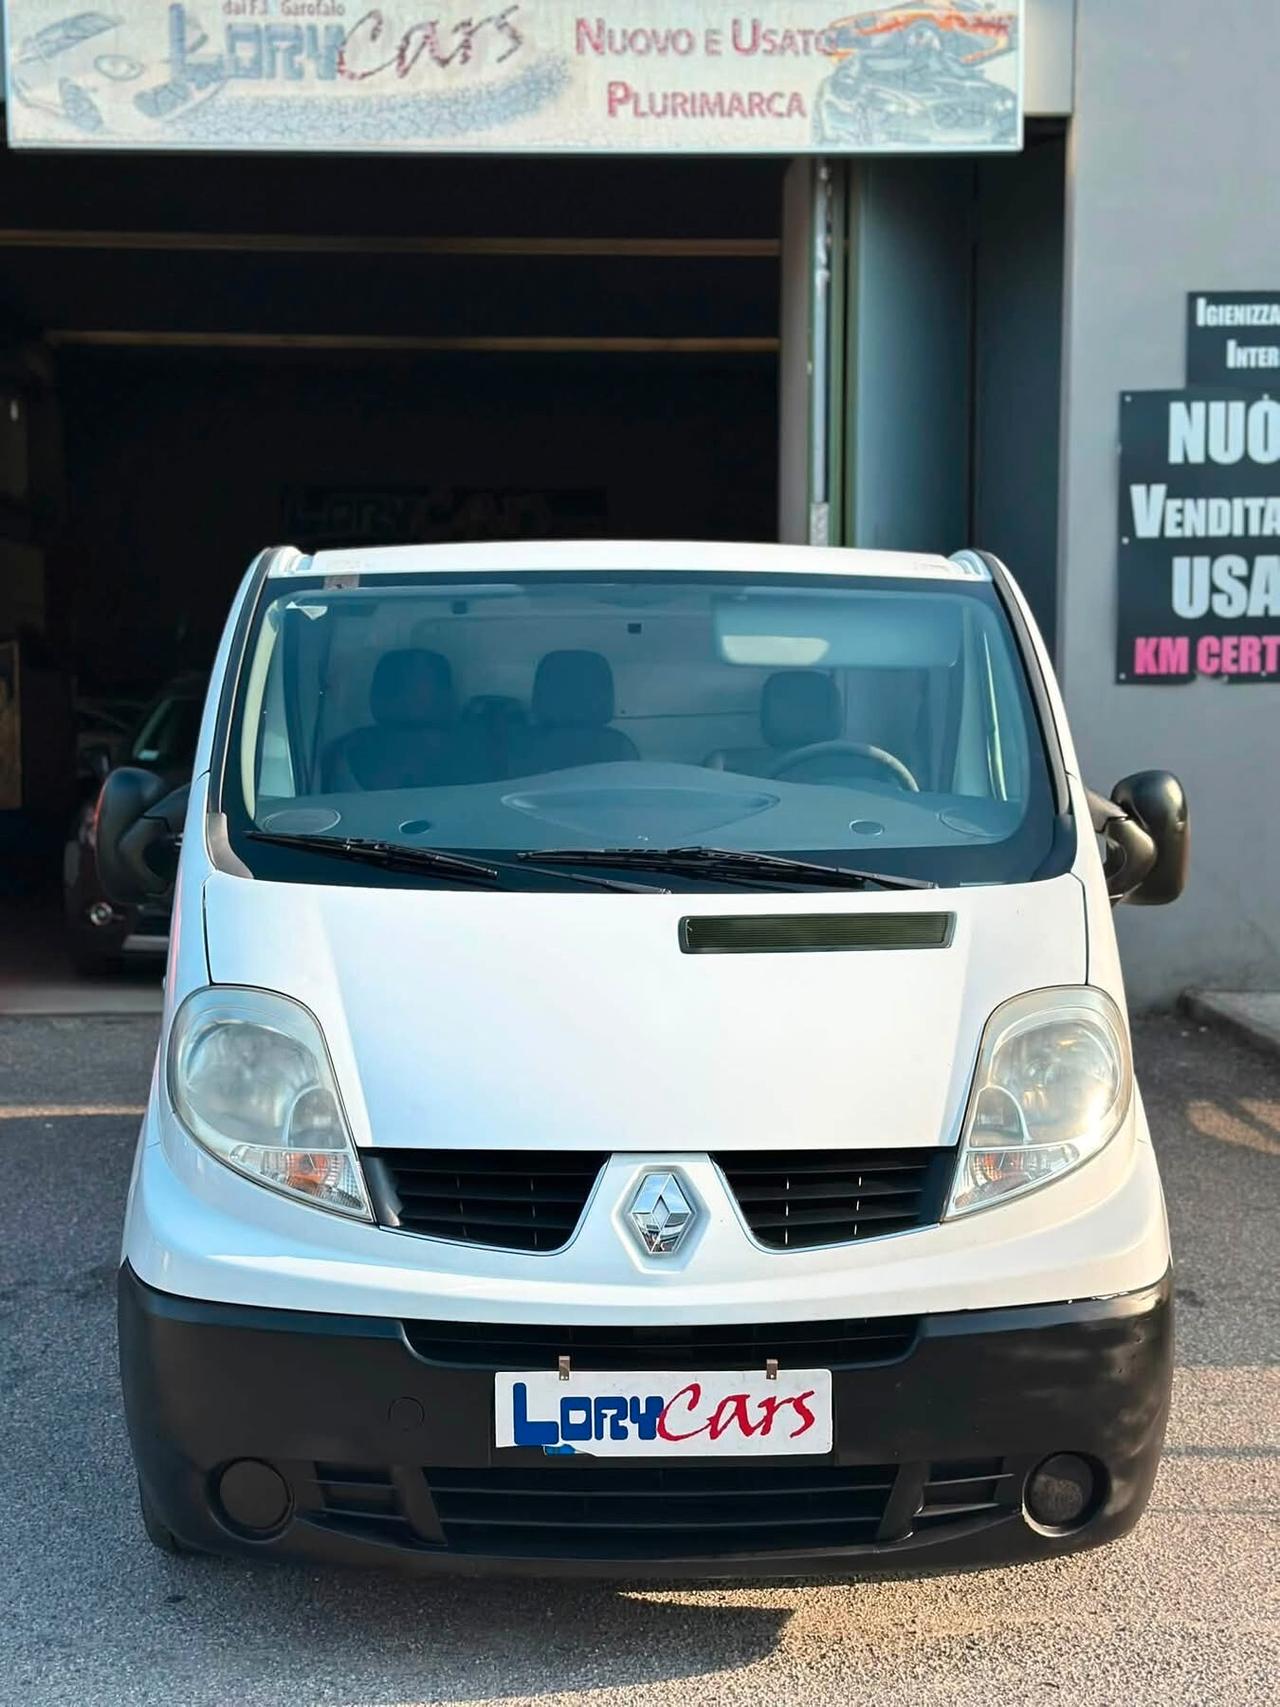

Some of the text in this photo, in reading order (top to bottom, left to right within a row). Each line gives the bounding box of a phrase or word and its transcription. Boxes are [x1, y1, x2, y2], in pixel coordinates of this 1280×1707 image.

[575, 18, 839, 57] NUOVO E USATO
[607, 81, 808, 119] PLURIMARCA
[1196, 297, 1280, 327] IGIENIZZA
[1226, 339, 1280, 369] INTER
[1130, 484, 1280, 539] VENDITA
[1171, 554, 1280, 619] USA
[1134, 634, 1280, 676] KM CERT
